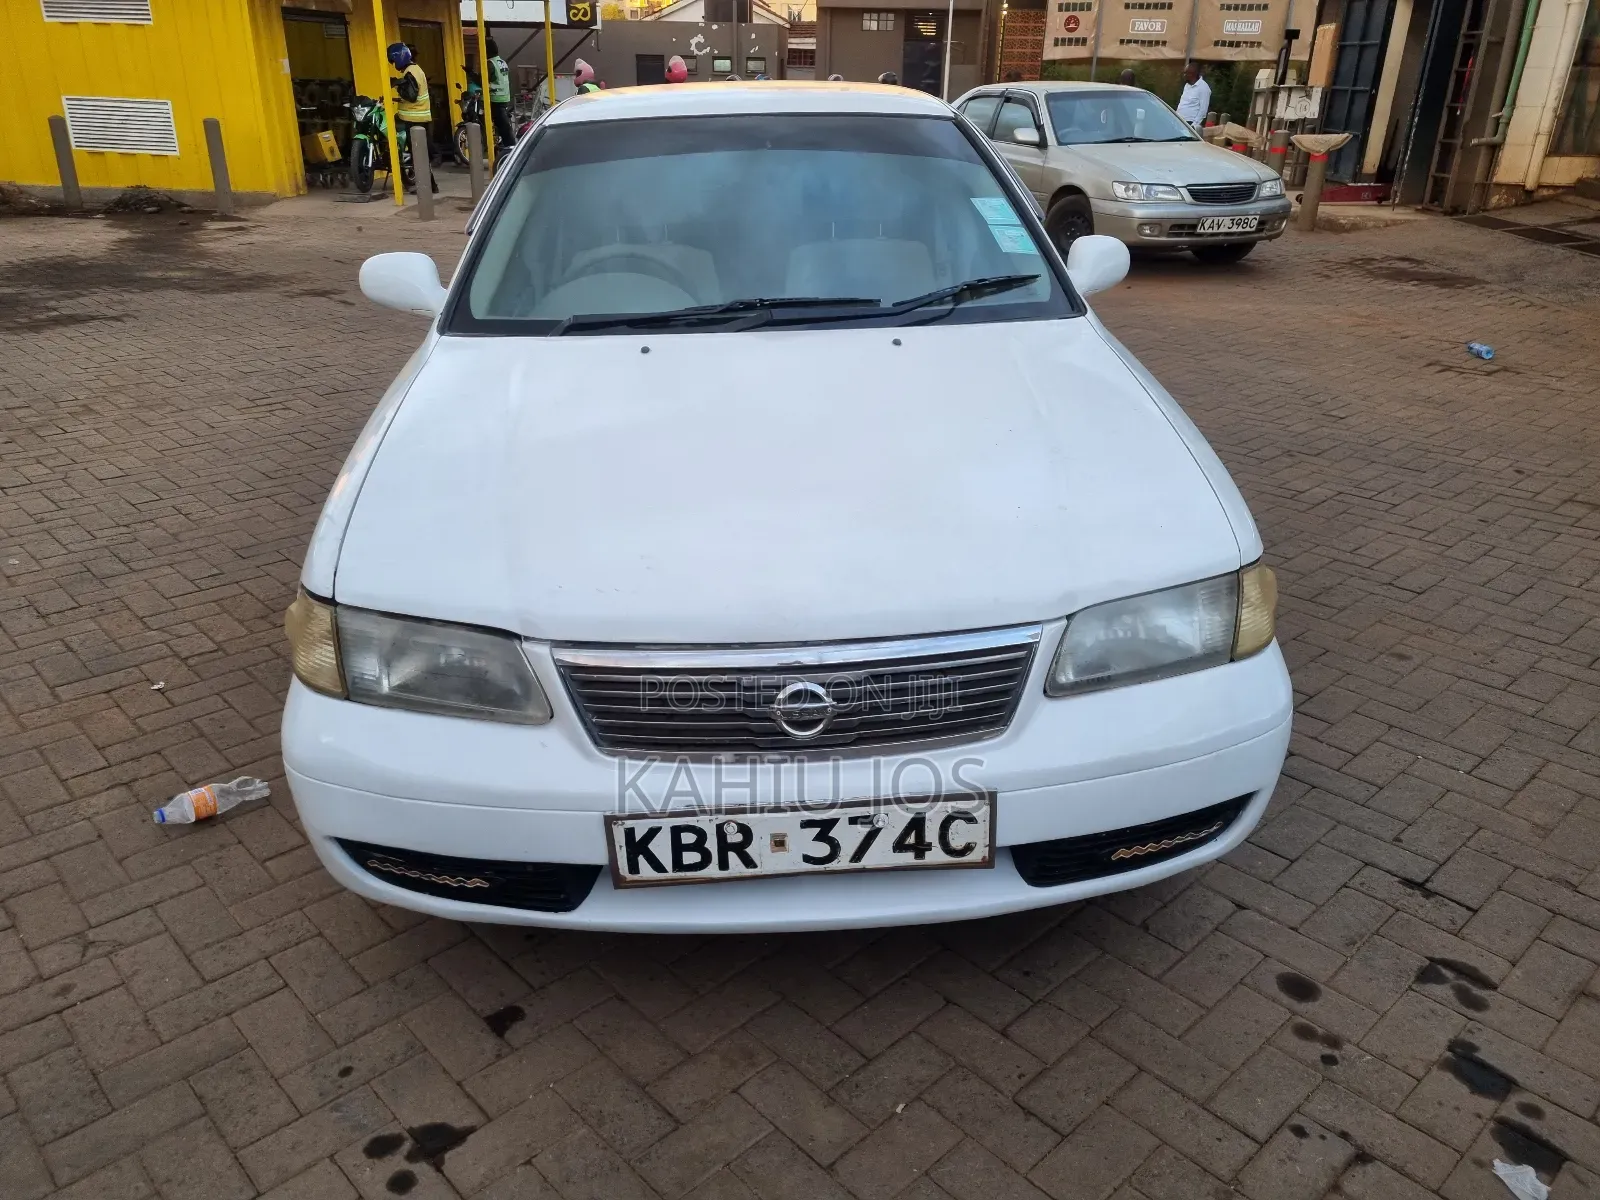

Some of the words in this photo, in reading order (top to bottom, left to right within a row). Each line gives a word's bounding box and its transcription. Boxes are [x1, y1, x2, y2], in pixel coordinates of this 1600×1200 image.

[1134, 21, 1162, 31] FAVOR
[1199, 218, 1224, 231] KAV
[1227, 217, 1258, 230] 398C
[623, 820, 759, 875] KBR
[800, 810, 979, 866] 374C
